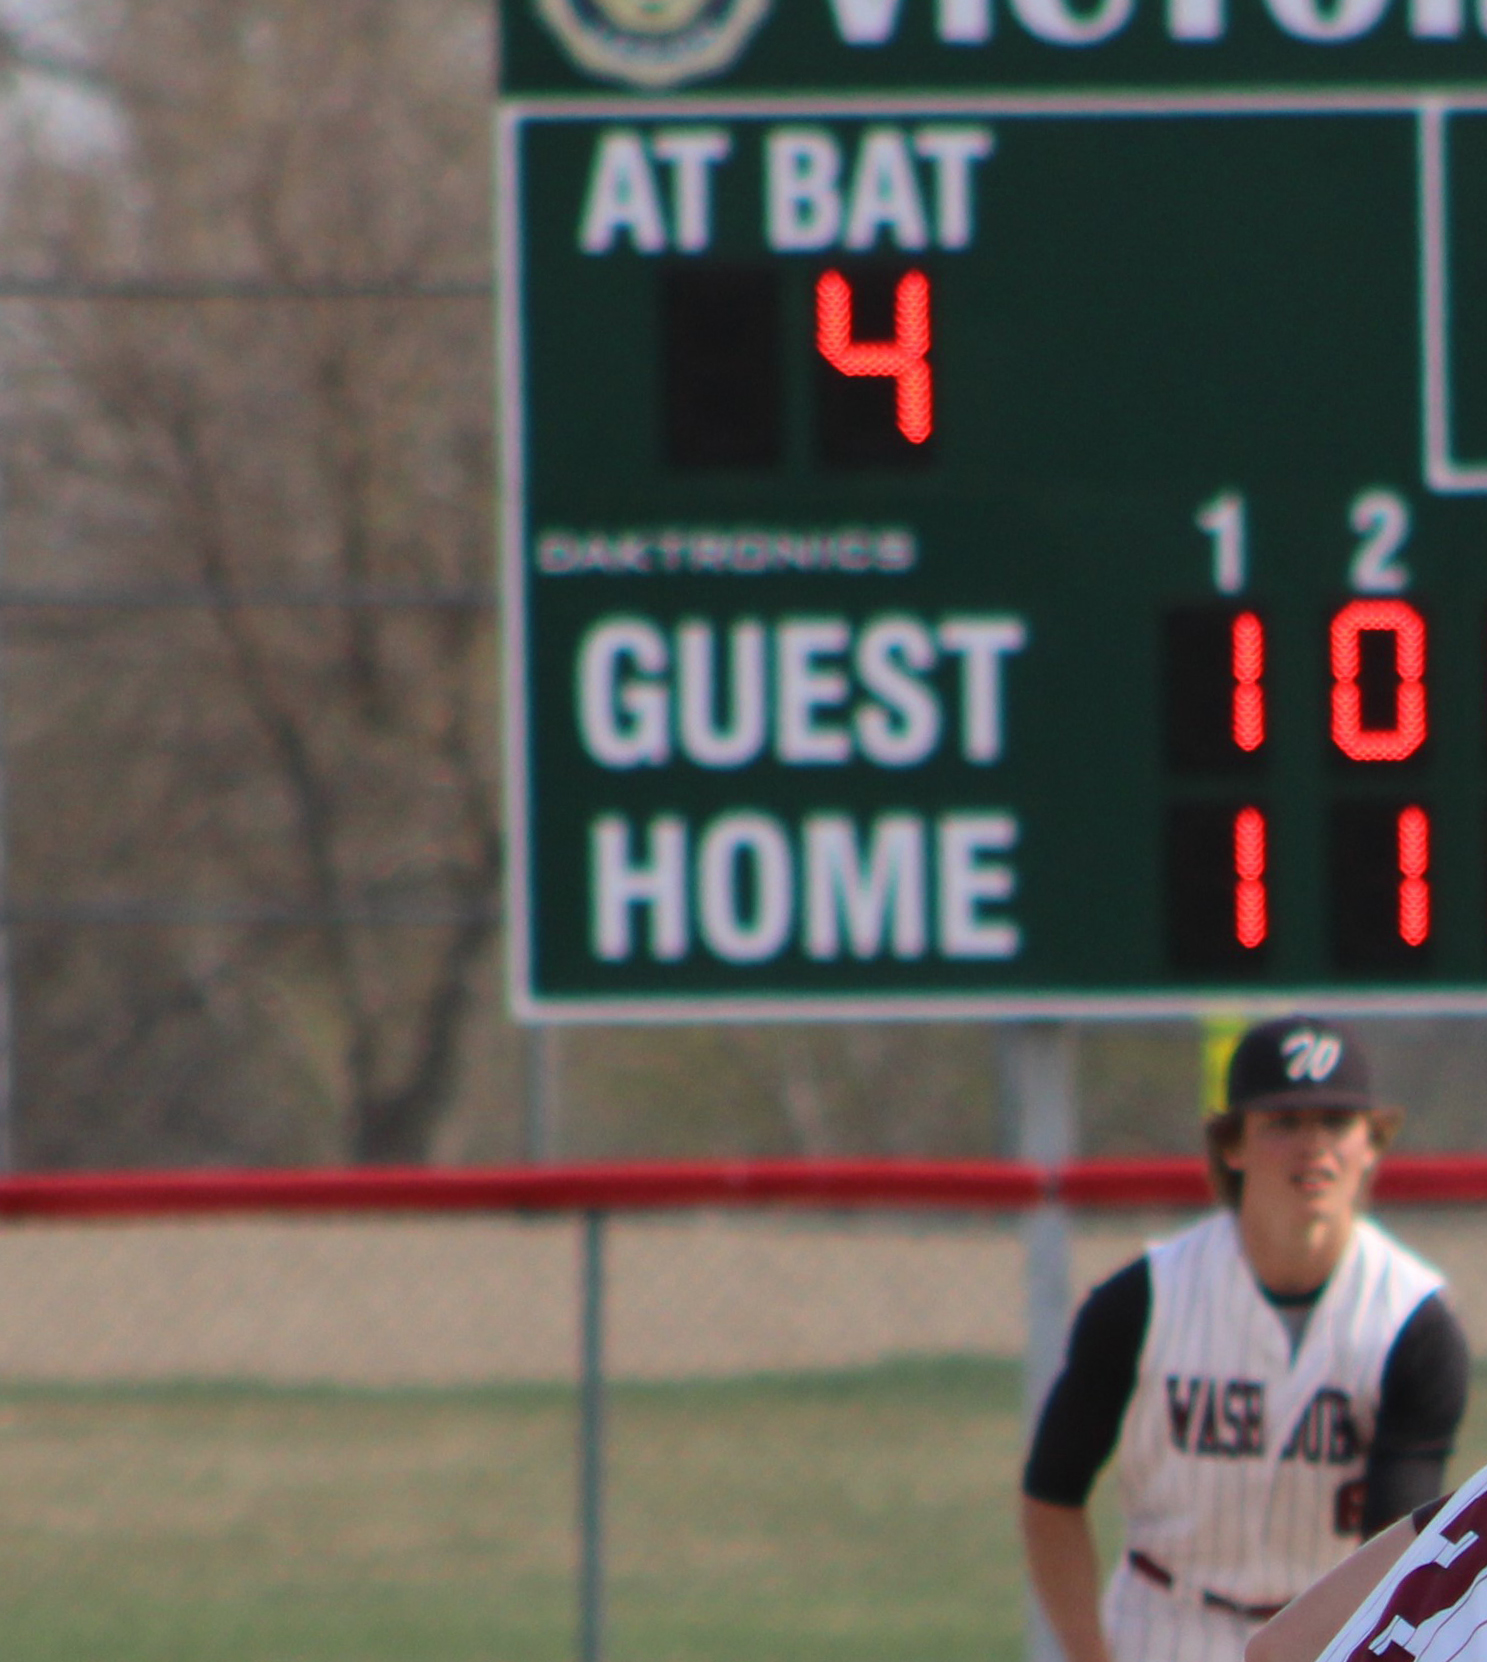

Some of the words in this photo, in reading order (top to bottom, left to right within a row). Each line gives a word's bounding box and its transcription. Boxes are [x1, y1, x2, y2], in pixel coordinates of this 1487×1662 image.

[583, 131, 728, 251] AT
[768, 129, 991, 248] BAT
[817, 271, 932, 444] 4
[1201, 498, 1241, 590] 1
[1354, 493, 1406, 590] 2
[580, 618, 1023, 764] GUEST
[1233, 614, 1264, 751] 1
[1331, 600, 1426, 761] 0
[594, 814, 1017, 959] HOME
[1235, 809, 1266, 948] 1
[1398, 808, 1429, 946] 1
